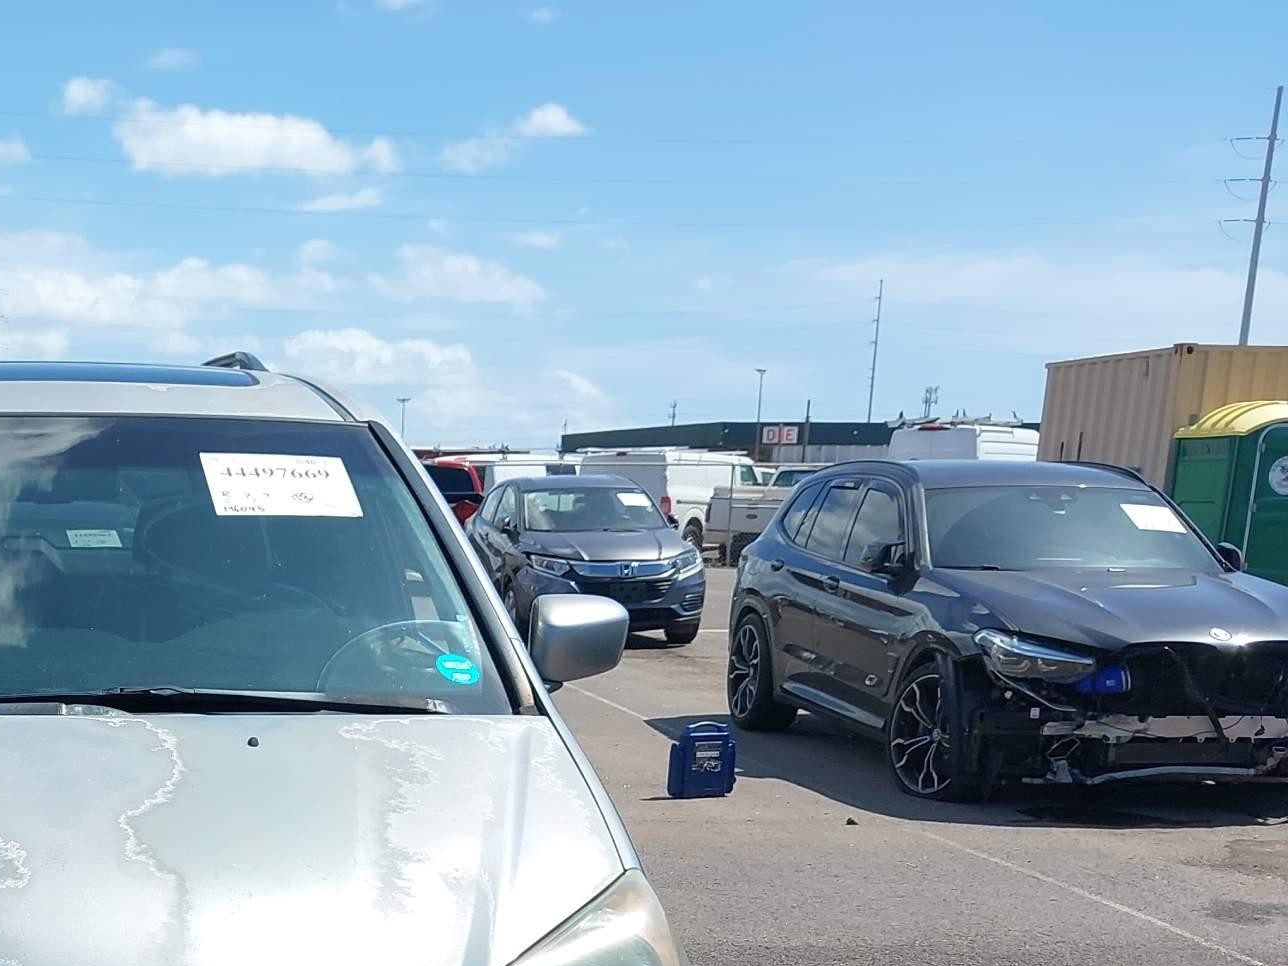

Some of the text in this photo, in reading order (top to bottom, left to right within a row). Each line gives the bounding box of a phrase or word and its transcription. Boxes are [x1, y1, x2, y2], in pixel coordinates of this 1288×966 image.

[767, 429, 794, 441] D E
[219, 466, 330, 480] 44497669
